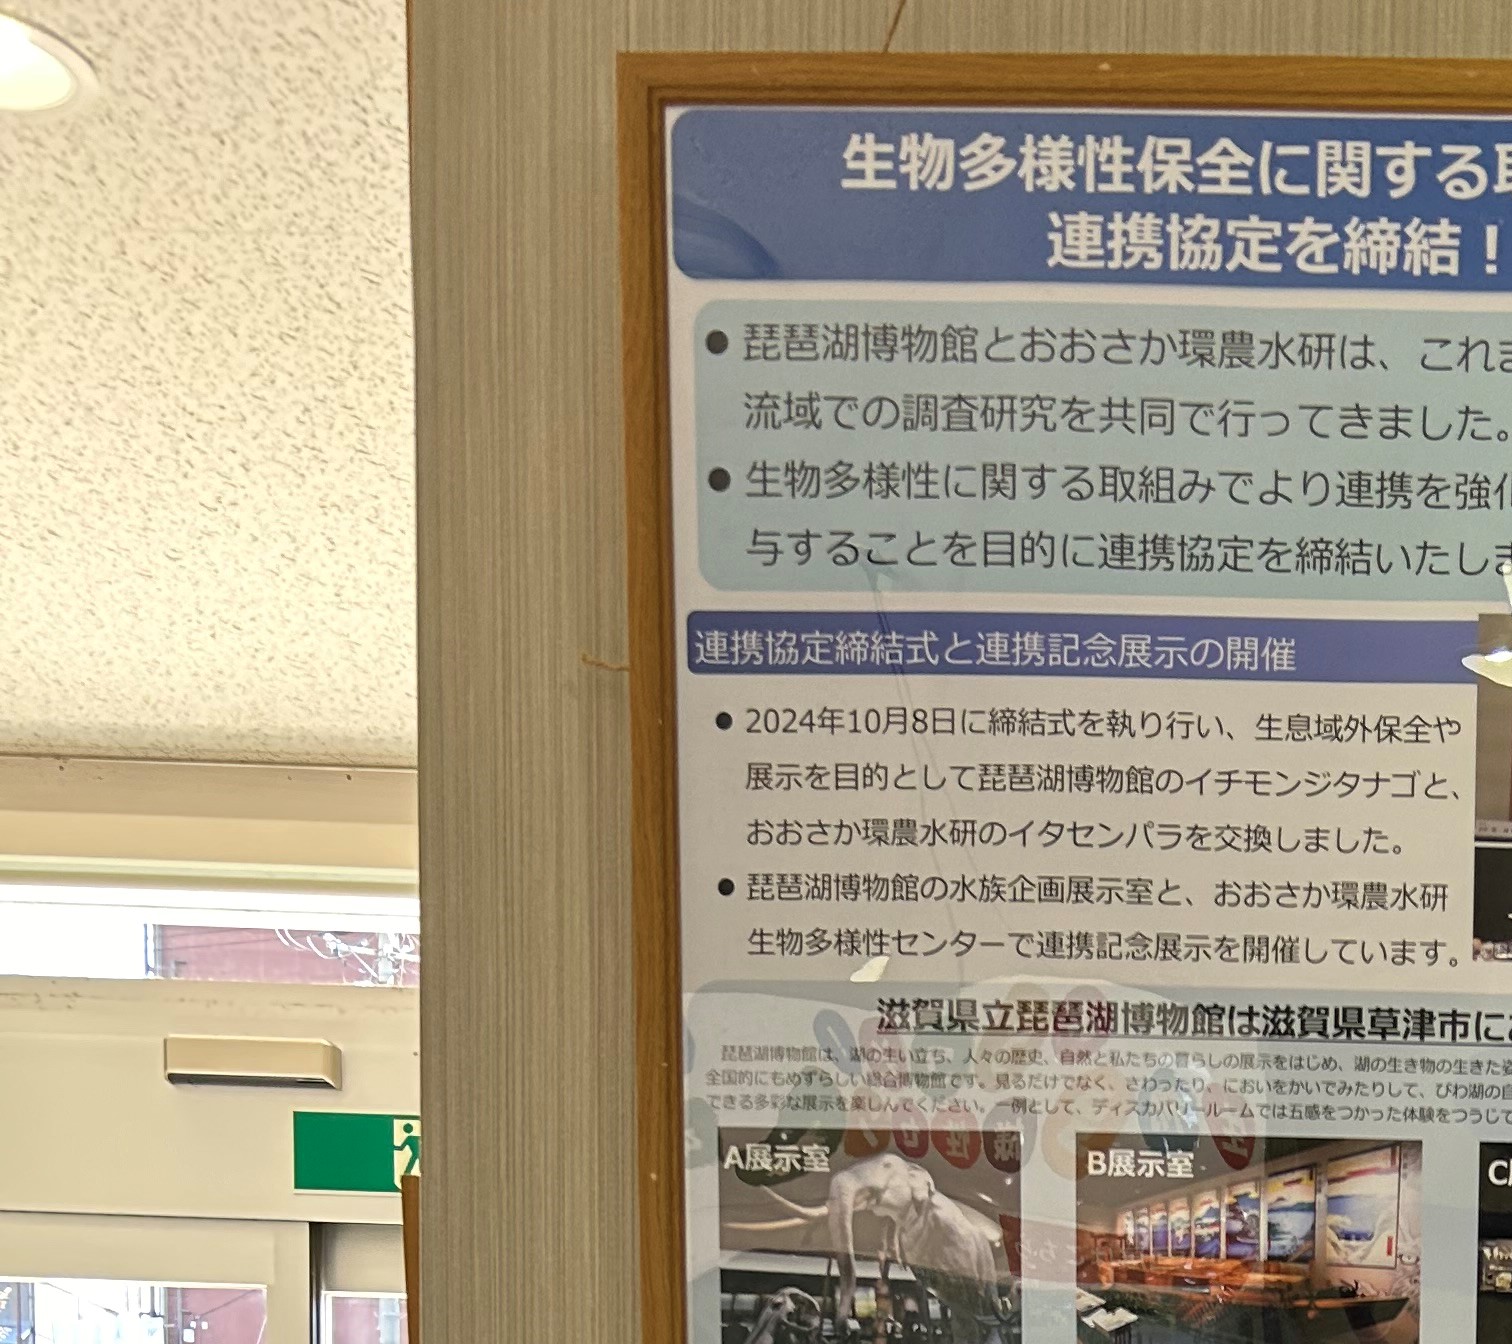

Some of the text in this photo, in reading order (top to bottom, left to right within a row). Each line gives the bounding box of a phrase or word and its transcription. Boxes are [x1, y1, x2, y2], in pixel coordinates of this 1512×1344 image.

[1046, 212, 1499, 275] 連携協定を締結！
[744, 391, 1511, 444] 流域での調査研究を共同で行ってきました。
[694, 628, 1297, 673] 連携協定締結式と連携記念展示の開催
[745, 706, 1462, 746] 2024年10月8日に締結式を執り行い、生息域外保全や
[746, 762, 1460, 801] 展示を目的として琵琶湖博物館のイチモンジタナゴと、
[746, 818, 1404, 856] おおさか環農水研のイタセンパラを交換しました。
[747, 873, 1448, 913] 琵琶湖博物館の水族企画展示室と、おおさか環農水研
[748, 927, 1463, 968] 生物多様性センターで連携記念展示を開催しています。
[723, 1142, 831, 1173] A展示室
[1087, 1149, 1194, 1178] B展示室
